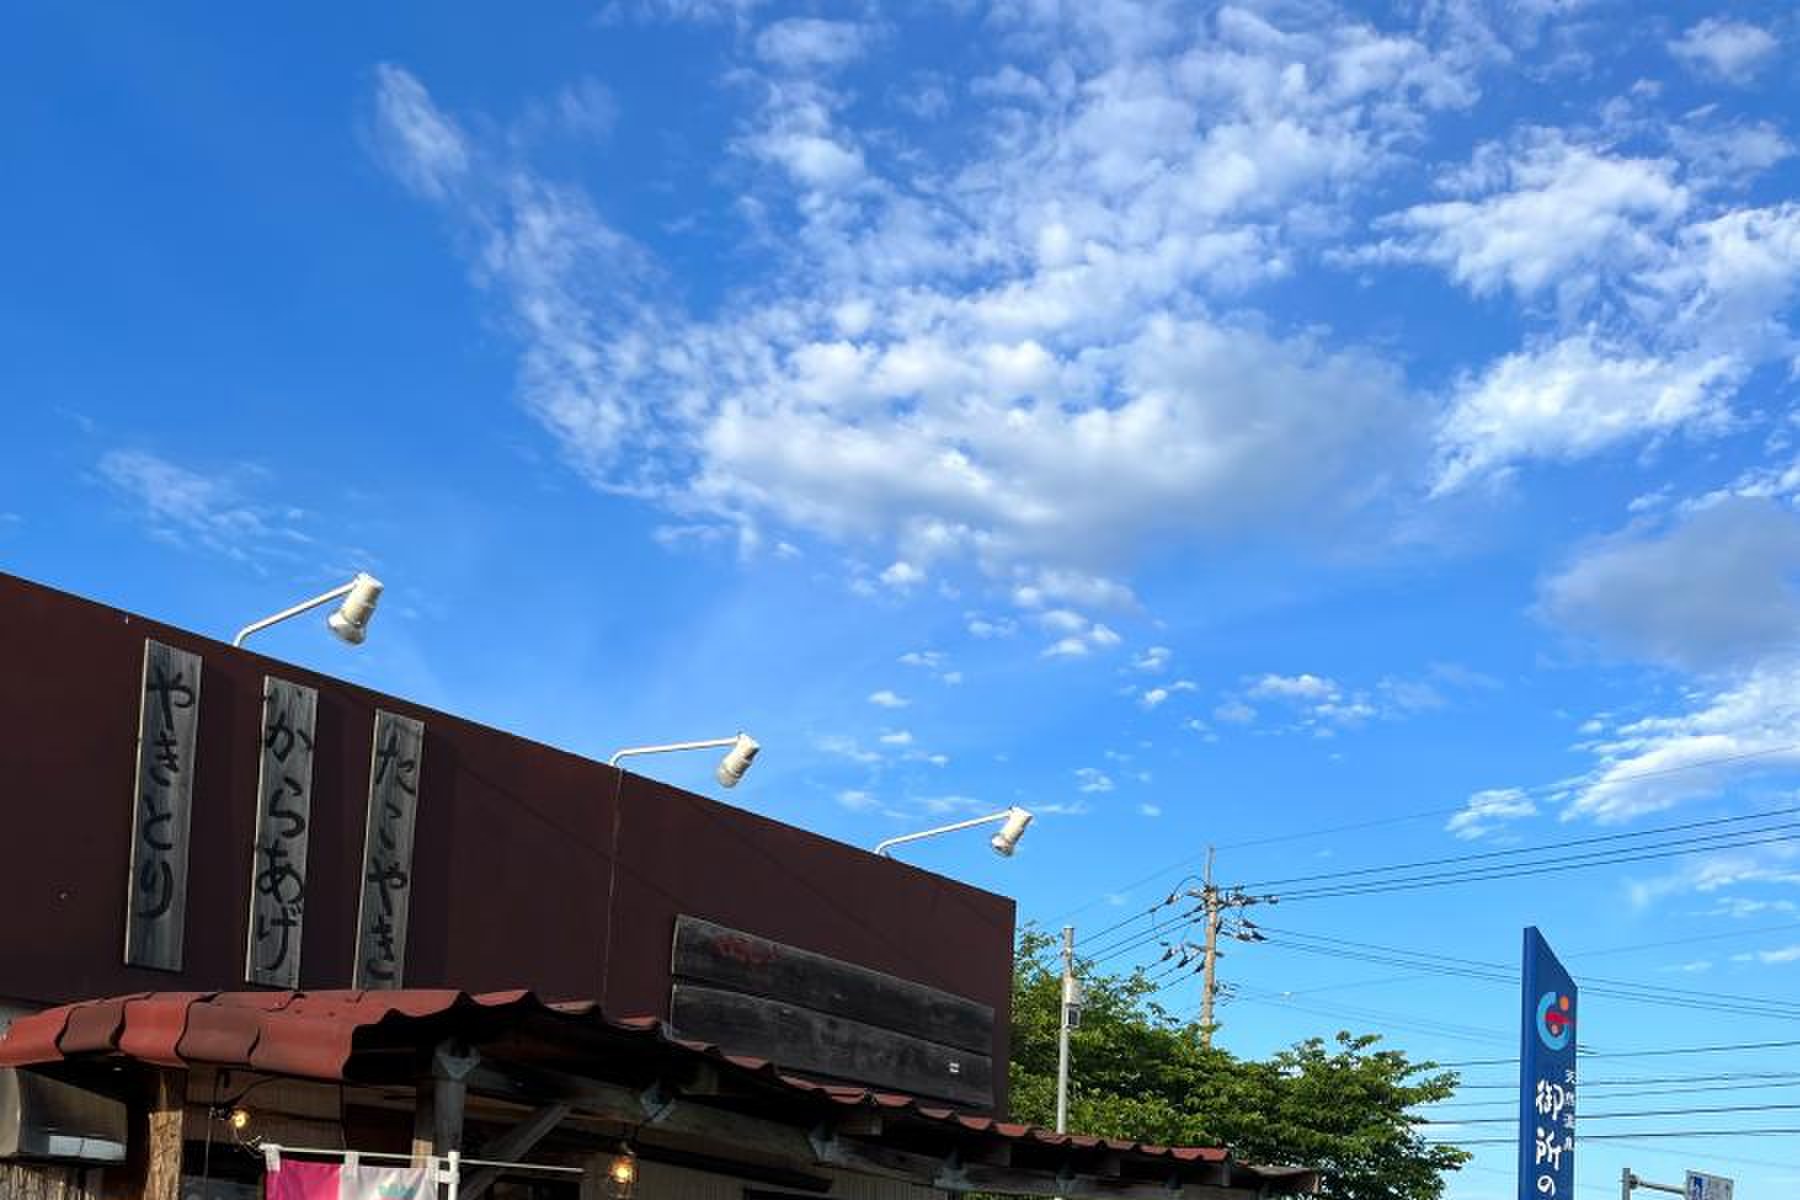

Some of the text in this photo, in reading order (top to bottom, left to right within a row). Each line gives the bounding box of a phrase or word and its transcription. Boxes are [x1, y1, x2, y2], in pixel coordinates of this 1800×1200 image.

[138, 667, 194, 919] やきとり
[256, 711, 313, 970] からあげ
[366, 730, 416, 976] たこやき
